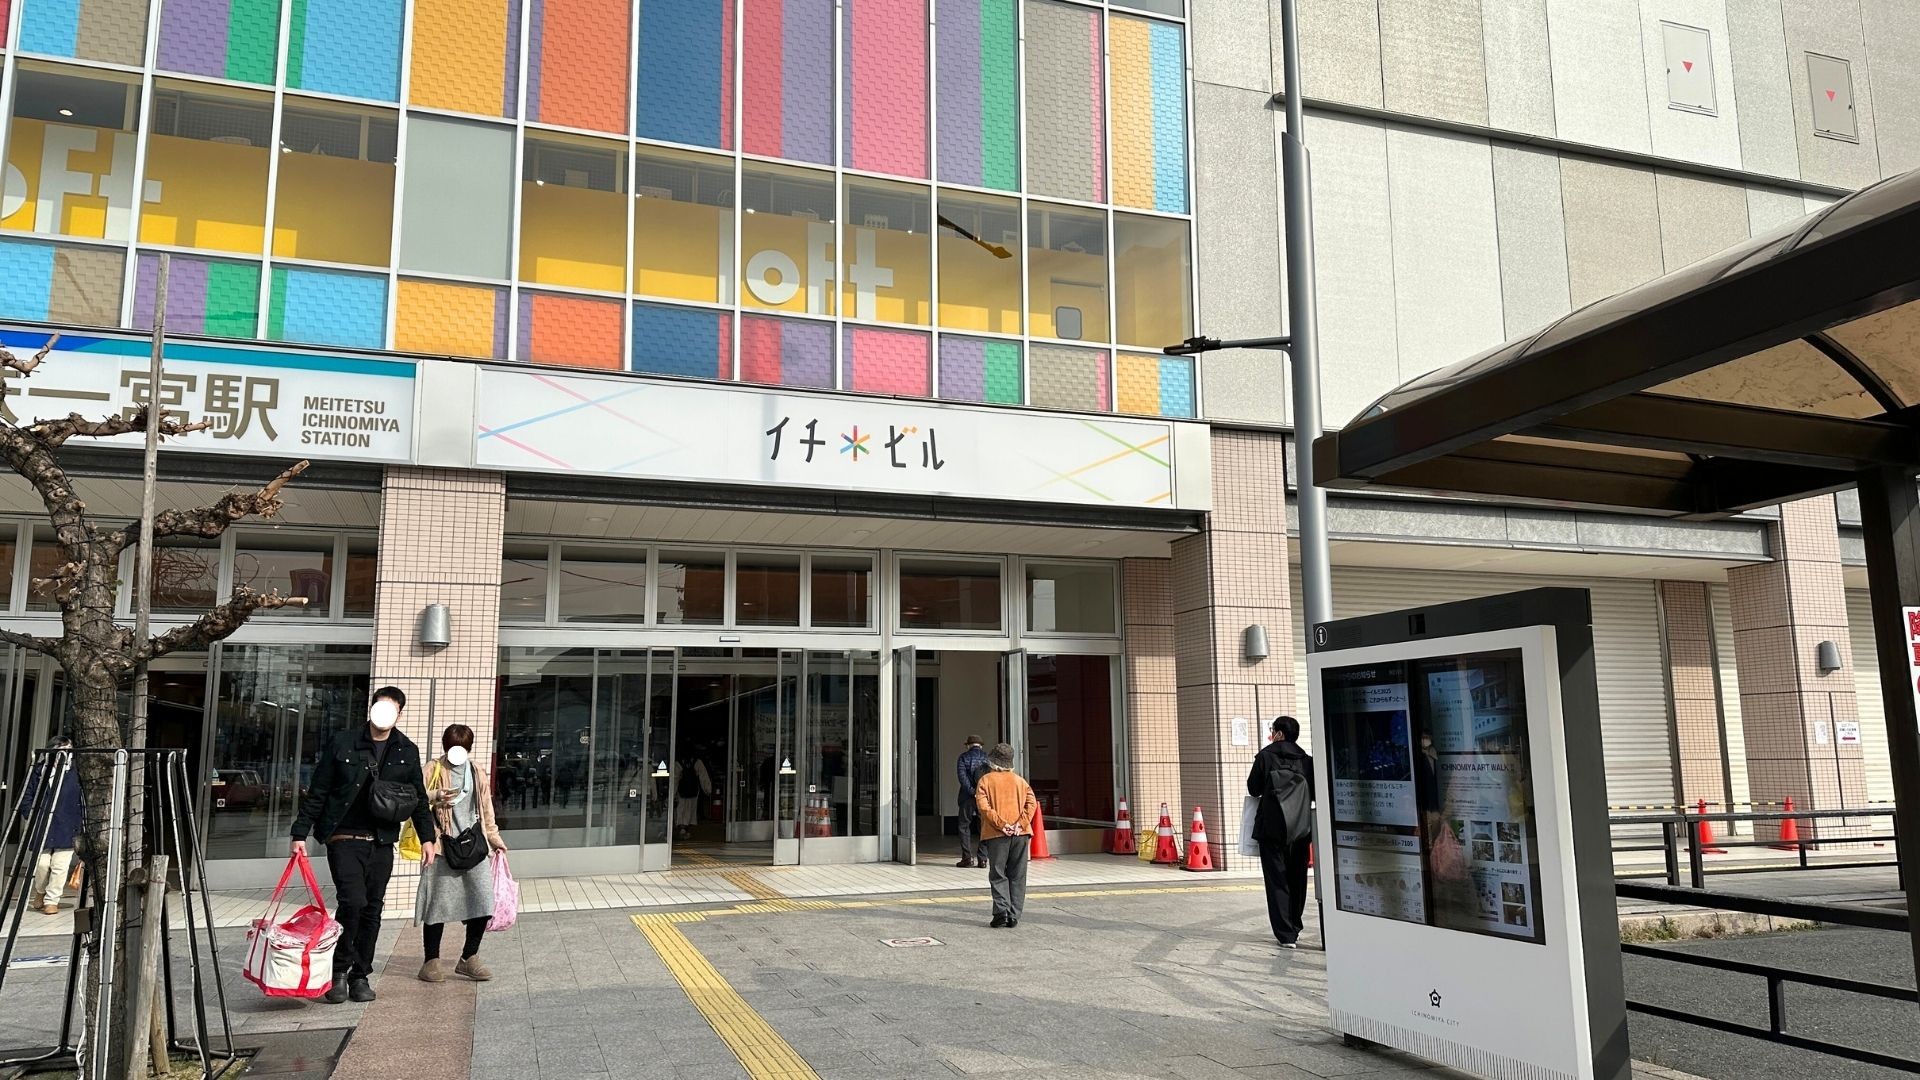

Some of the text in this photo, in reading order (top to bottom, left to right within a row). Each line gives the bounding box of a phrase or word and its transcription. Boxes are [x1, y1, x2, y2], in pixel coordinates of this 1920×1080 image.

[719, 209, 894, 321] loft
[0, 368, 279, 442] 一宮駅
[303, 396, 385, 415] MEITETSU
[302, 412, 400, 433] ICHINOMIYA
[301, 430, 371, 448] STATION
[1477, 763, 1490, 772] ART
